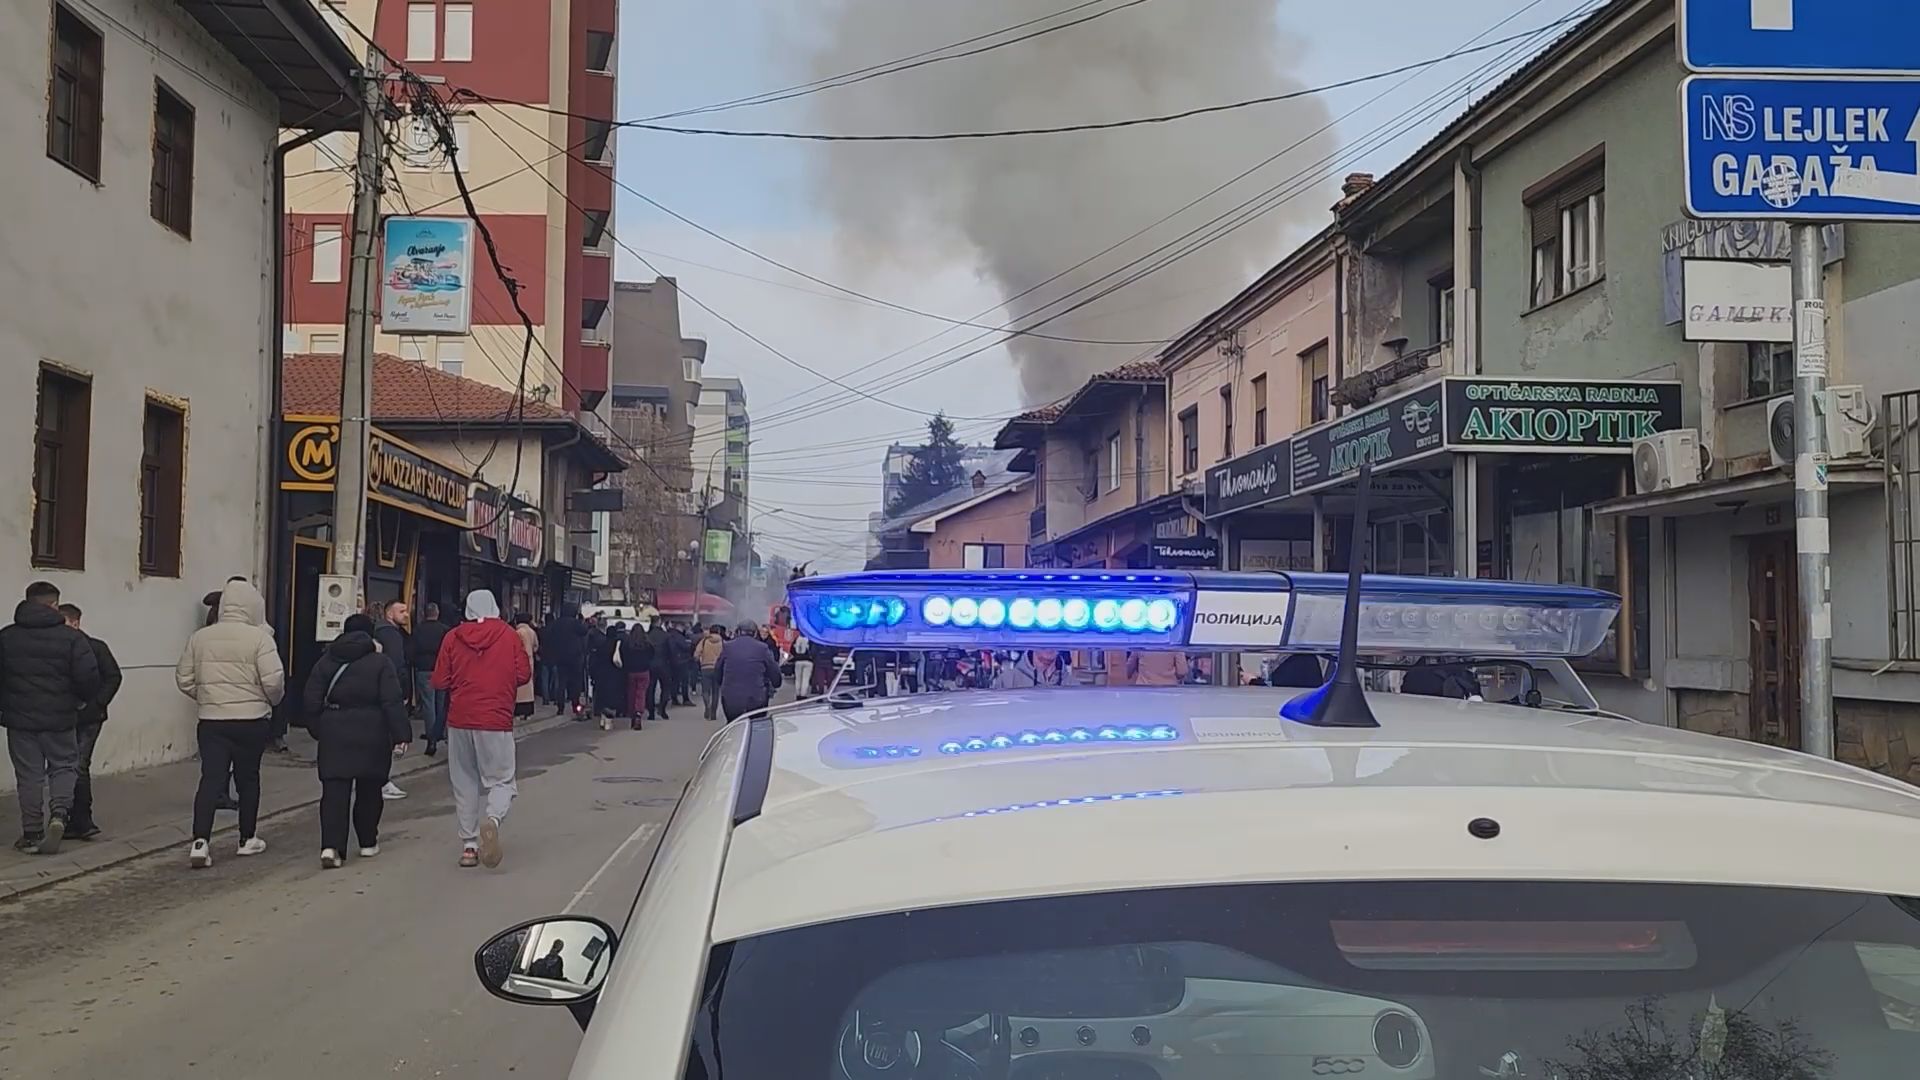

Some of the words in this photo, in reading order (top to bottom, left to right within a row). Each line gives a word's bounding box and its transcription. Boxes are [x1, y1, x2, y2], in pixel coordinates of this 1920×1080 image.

[1702, 94, 1756, 141] NS
[1763, 107, 1890, 142] LEJLEK
[1689, 305, 1793, 323] GAMEK
[1465, 383, 1583, 402] OPTIČARSKA
[1585, 387, 1660, 404] RADNJA
[1461, 407, 1663, 442] AKIOPTIK
[1328, 427, 1393, 477] AKIOPTIK
[383, 453, 427, 498] MOZZART
[427, 471, 448, 502] SLOT
[449, 482, 467, 510] CLUB
[1195, 613, 1283, 627] ПОЛИЦИЈА
[1312, 1055, 1365, 1076] 500
